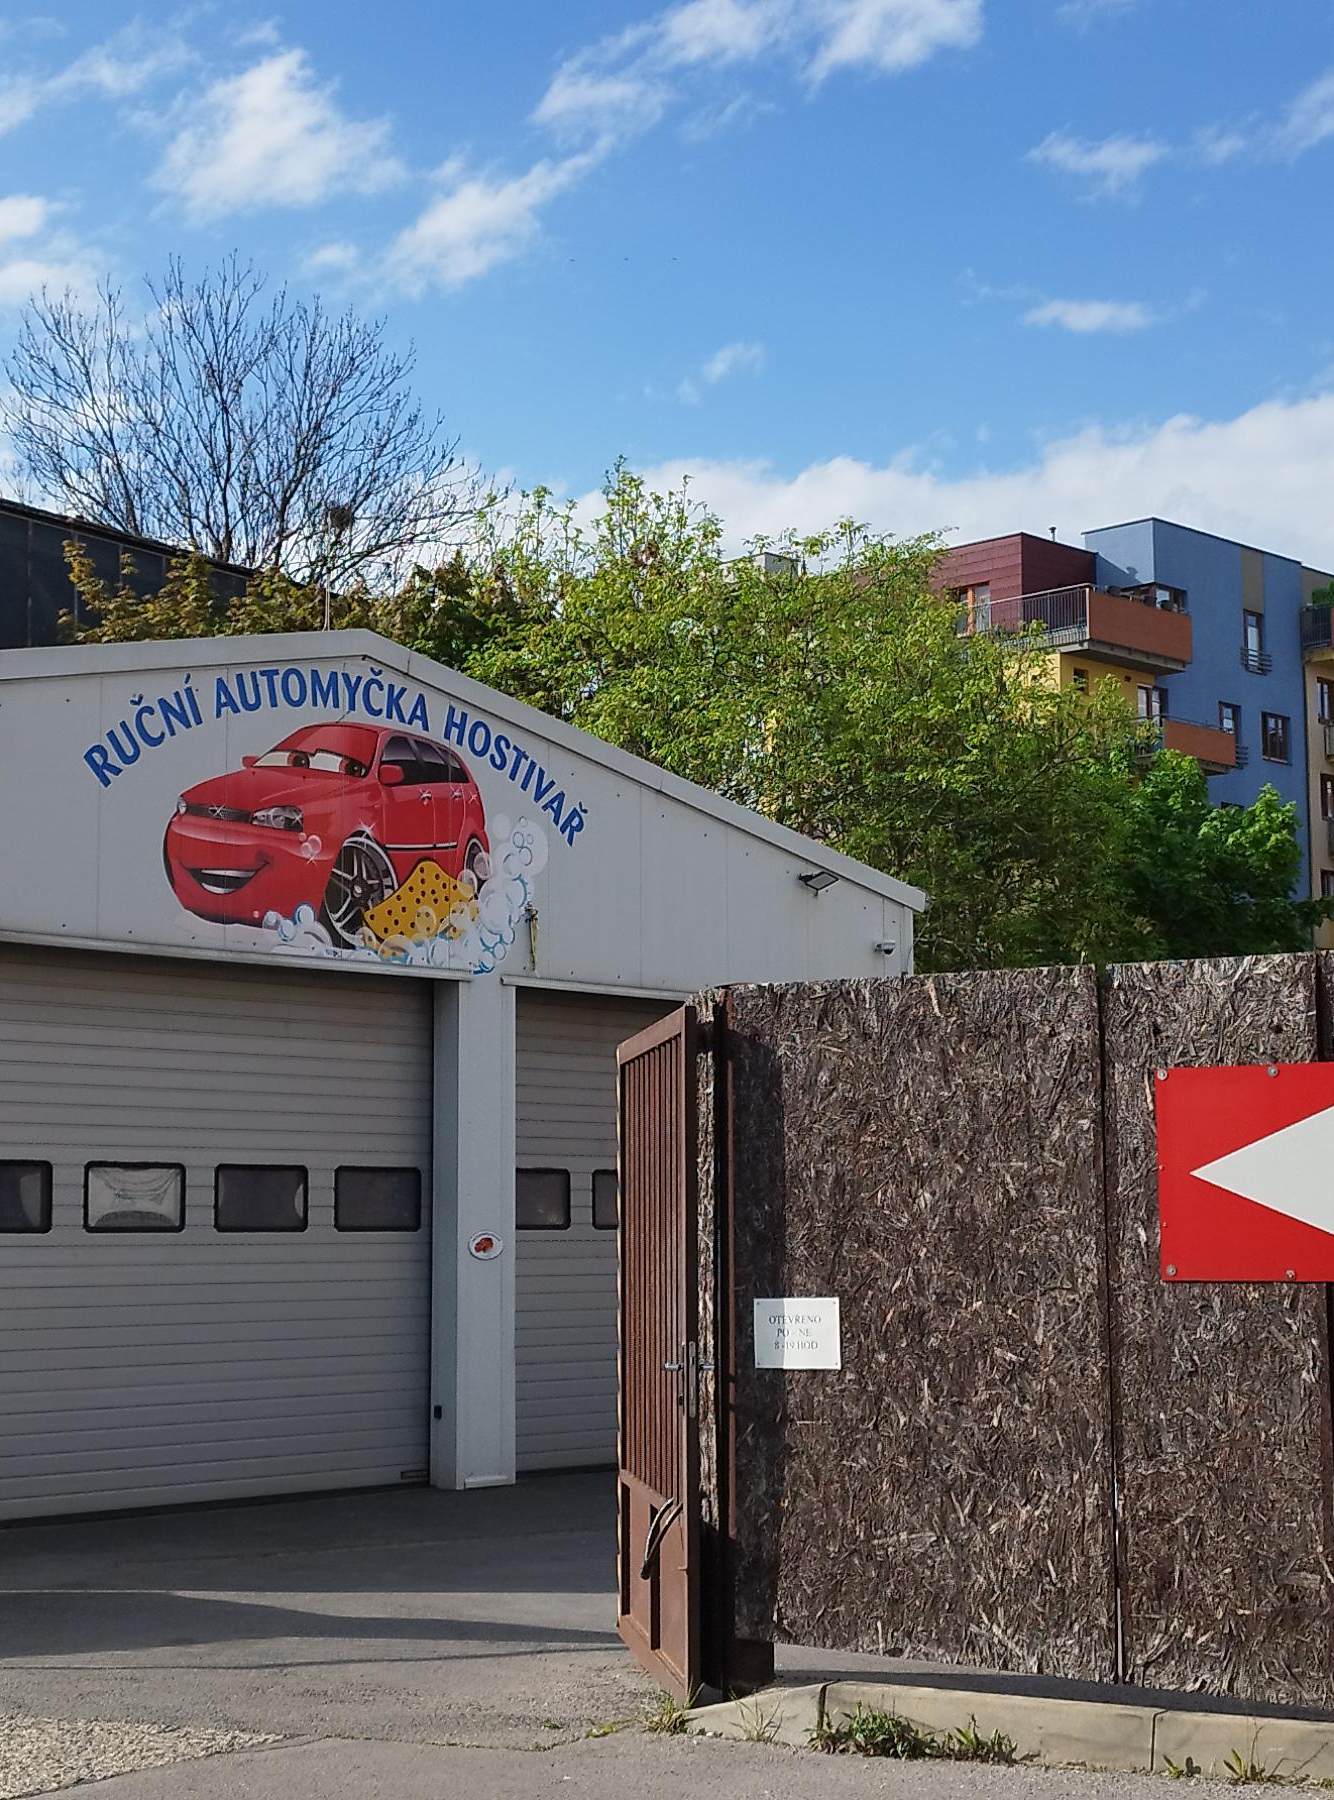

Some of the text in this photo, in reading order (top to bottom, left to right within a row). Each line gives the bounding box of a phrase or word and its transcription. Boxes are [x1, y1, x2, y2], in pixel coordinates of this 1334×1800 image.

[83, 667, 588, 847] RUČNÍ AUTOMYČKA HOSTIVAŘ
